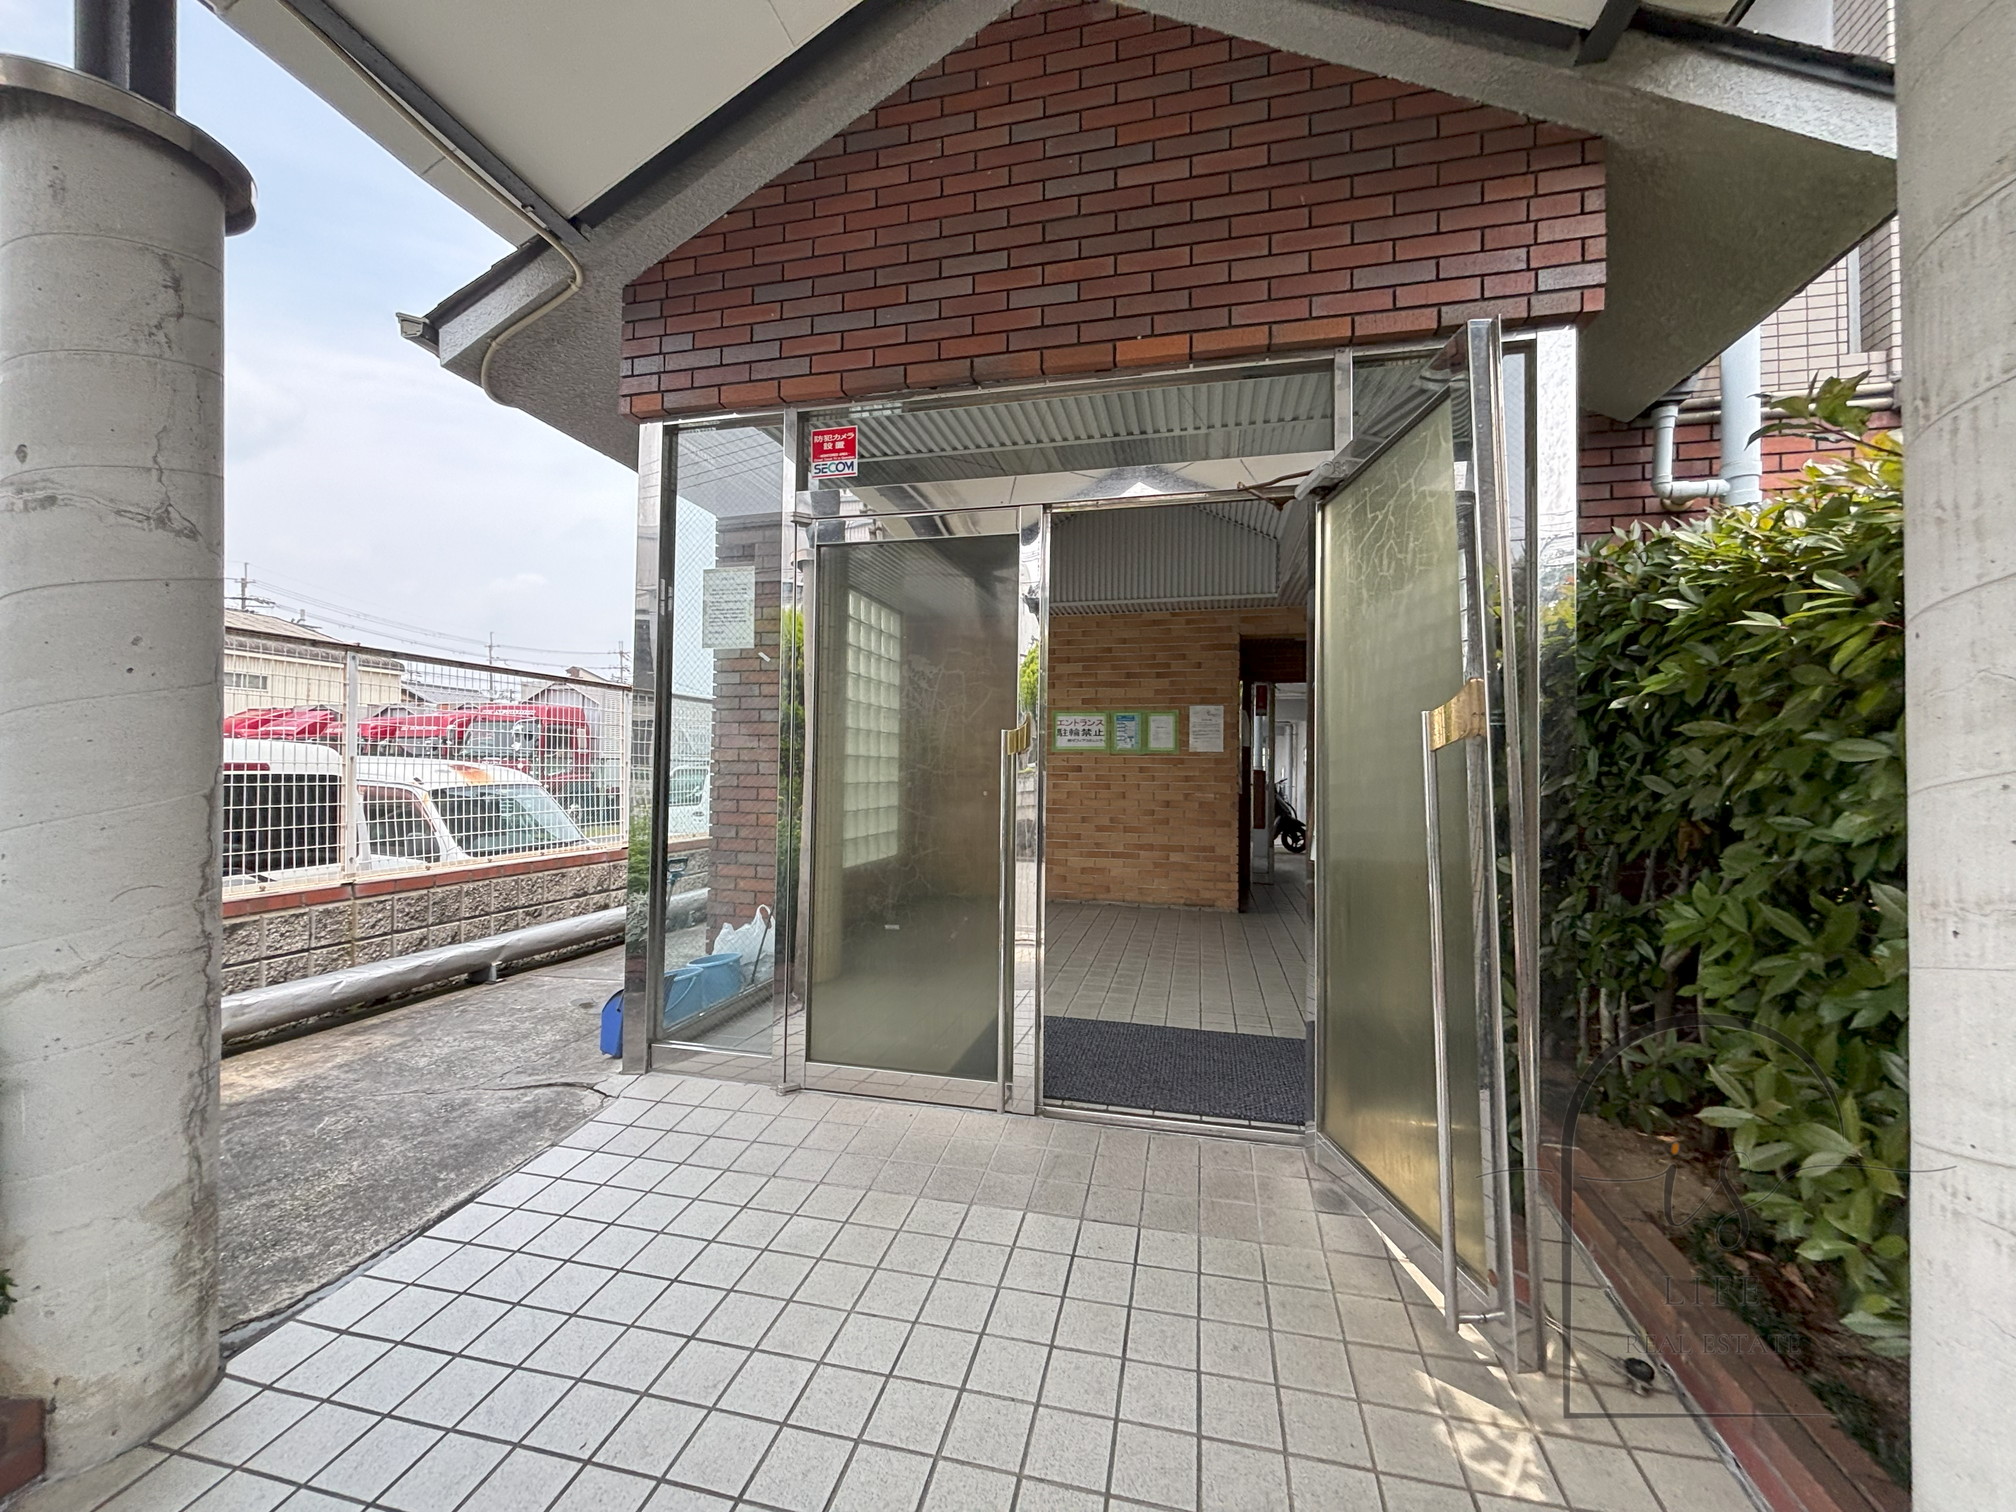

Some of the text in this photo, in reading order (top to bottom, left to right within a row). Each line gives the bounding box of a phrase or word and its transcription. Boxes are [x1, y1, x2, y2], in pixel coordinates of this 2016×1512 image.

[814, 432, 855, 443] 防犯カメラ
[823, 441, 845, 450] 設置
[814, 461, 854, 474] SECOM
[1057, 718, 1104, 727] エントランス
[1057, 728, 1105, 737] 駐輪禁止
